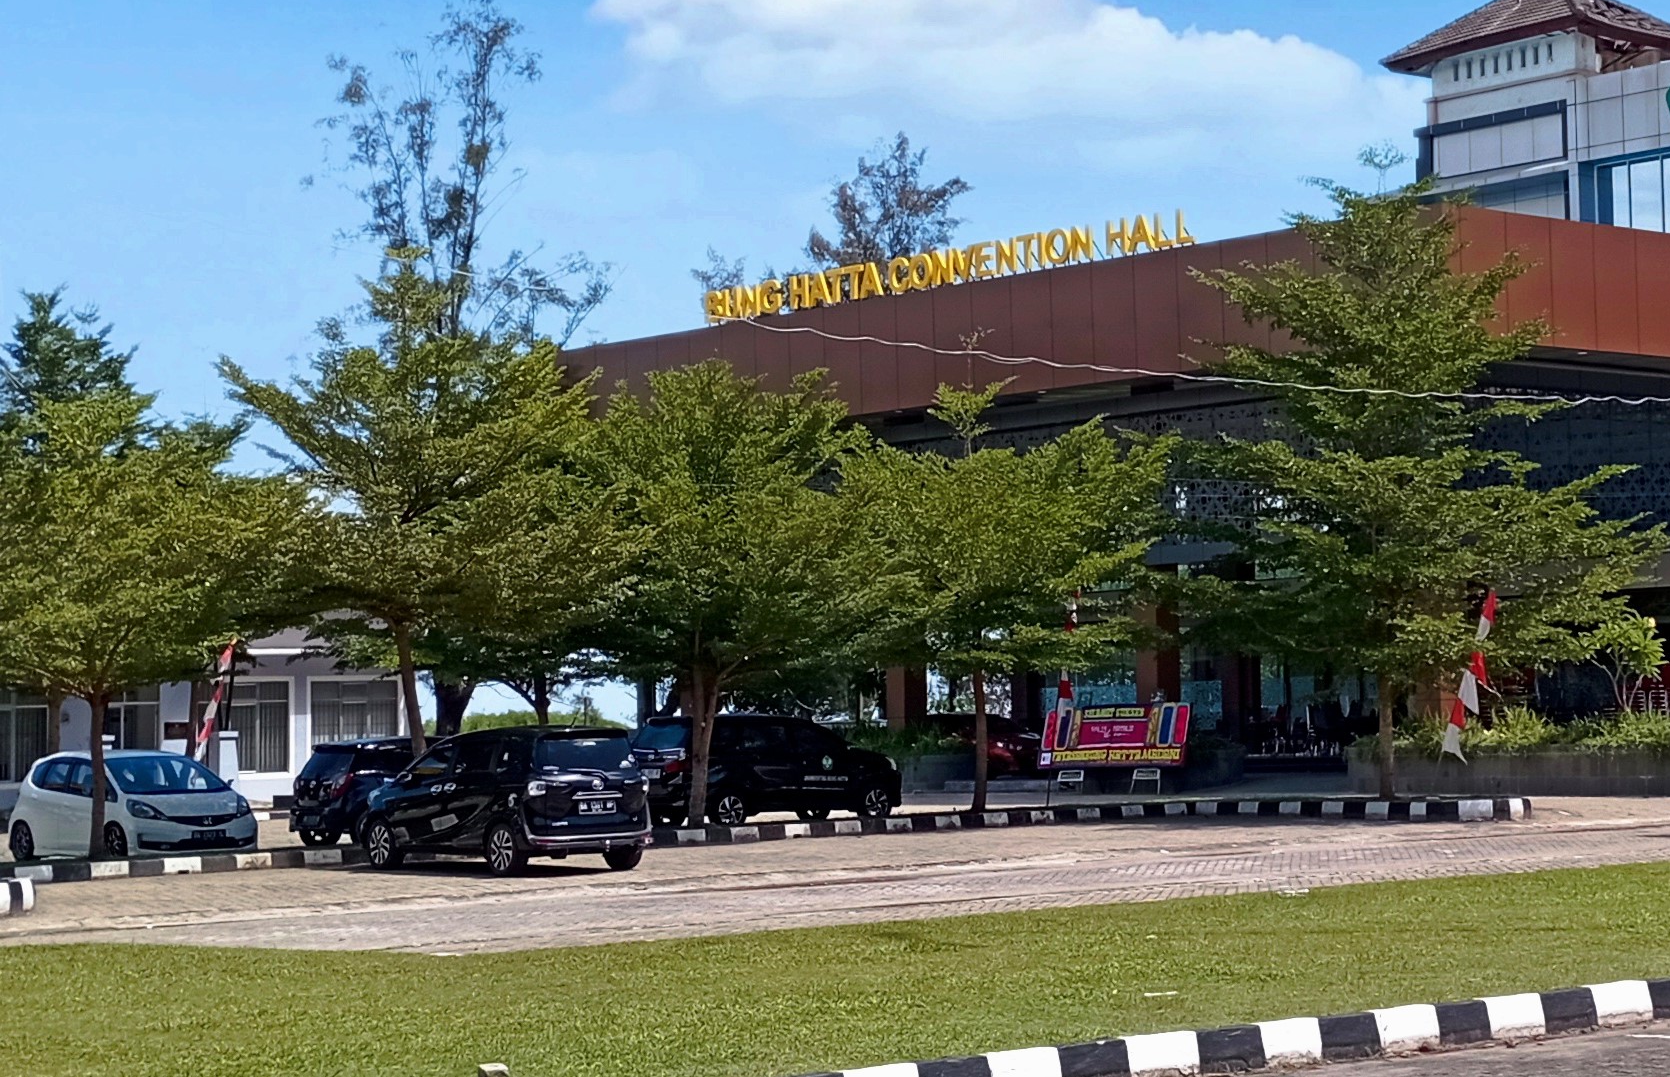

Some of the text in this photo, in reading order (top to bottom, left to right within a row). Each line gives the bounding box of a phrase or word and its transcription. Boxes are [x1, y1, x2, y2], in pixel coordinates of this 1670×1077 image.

[705, 208, 1194, 321] BUNG HATTA CONVENTION HALL
